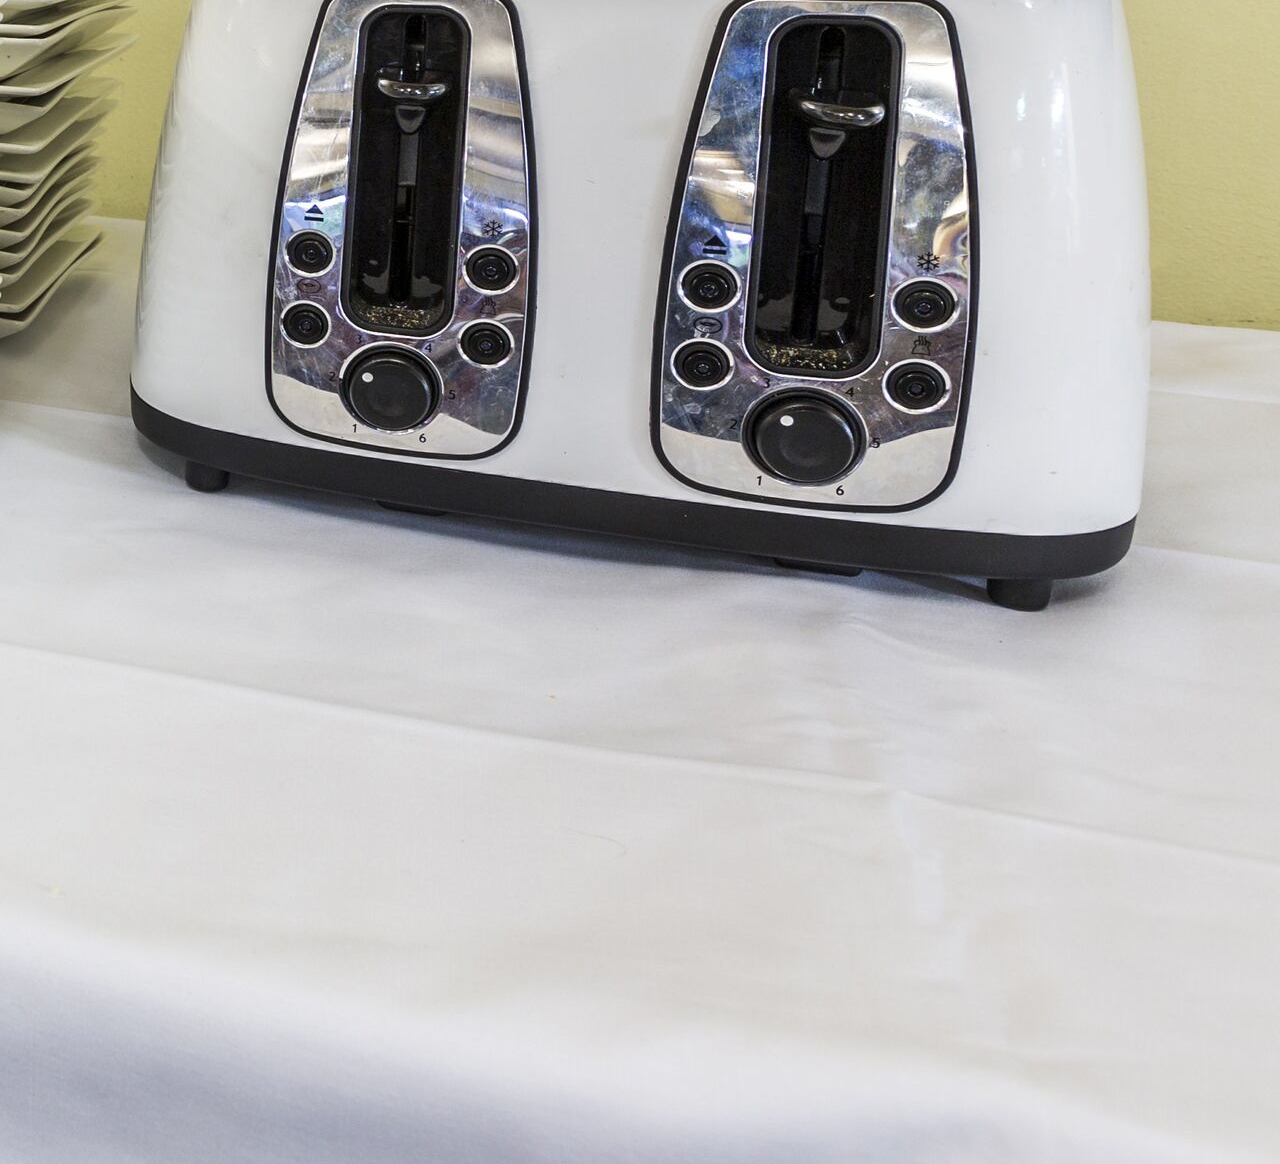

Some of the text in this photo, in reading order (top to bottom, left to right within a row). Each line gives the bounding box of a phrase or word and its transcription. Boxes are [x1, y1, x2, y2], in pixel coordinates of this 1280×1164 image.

[424, 343, 432, 353] 4
[329, 372, 336, 382] 2
[763, 377, 771, 388] 3
[448, 389, 456, 400] 5
[845, 387, 854, 397] 4
[352, 423, 357, 433] 1
[729, 419, 737, 430] 2
[419, 433, 427, 444] 6
[871, 438, 880, 449] 5
[756, 475, 762, 486] 1
[836, 485, 845, 496] 6
